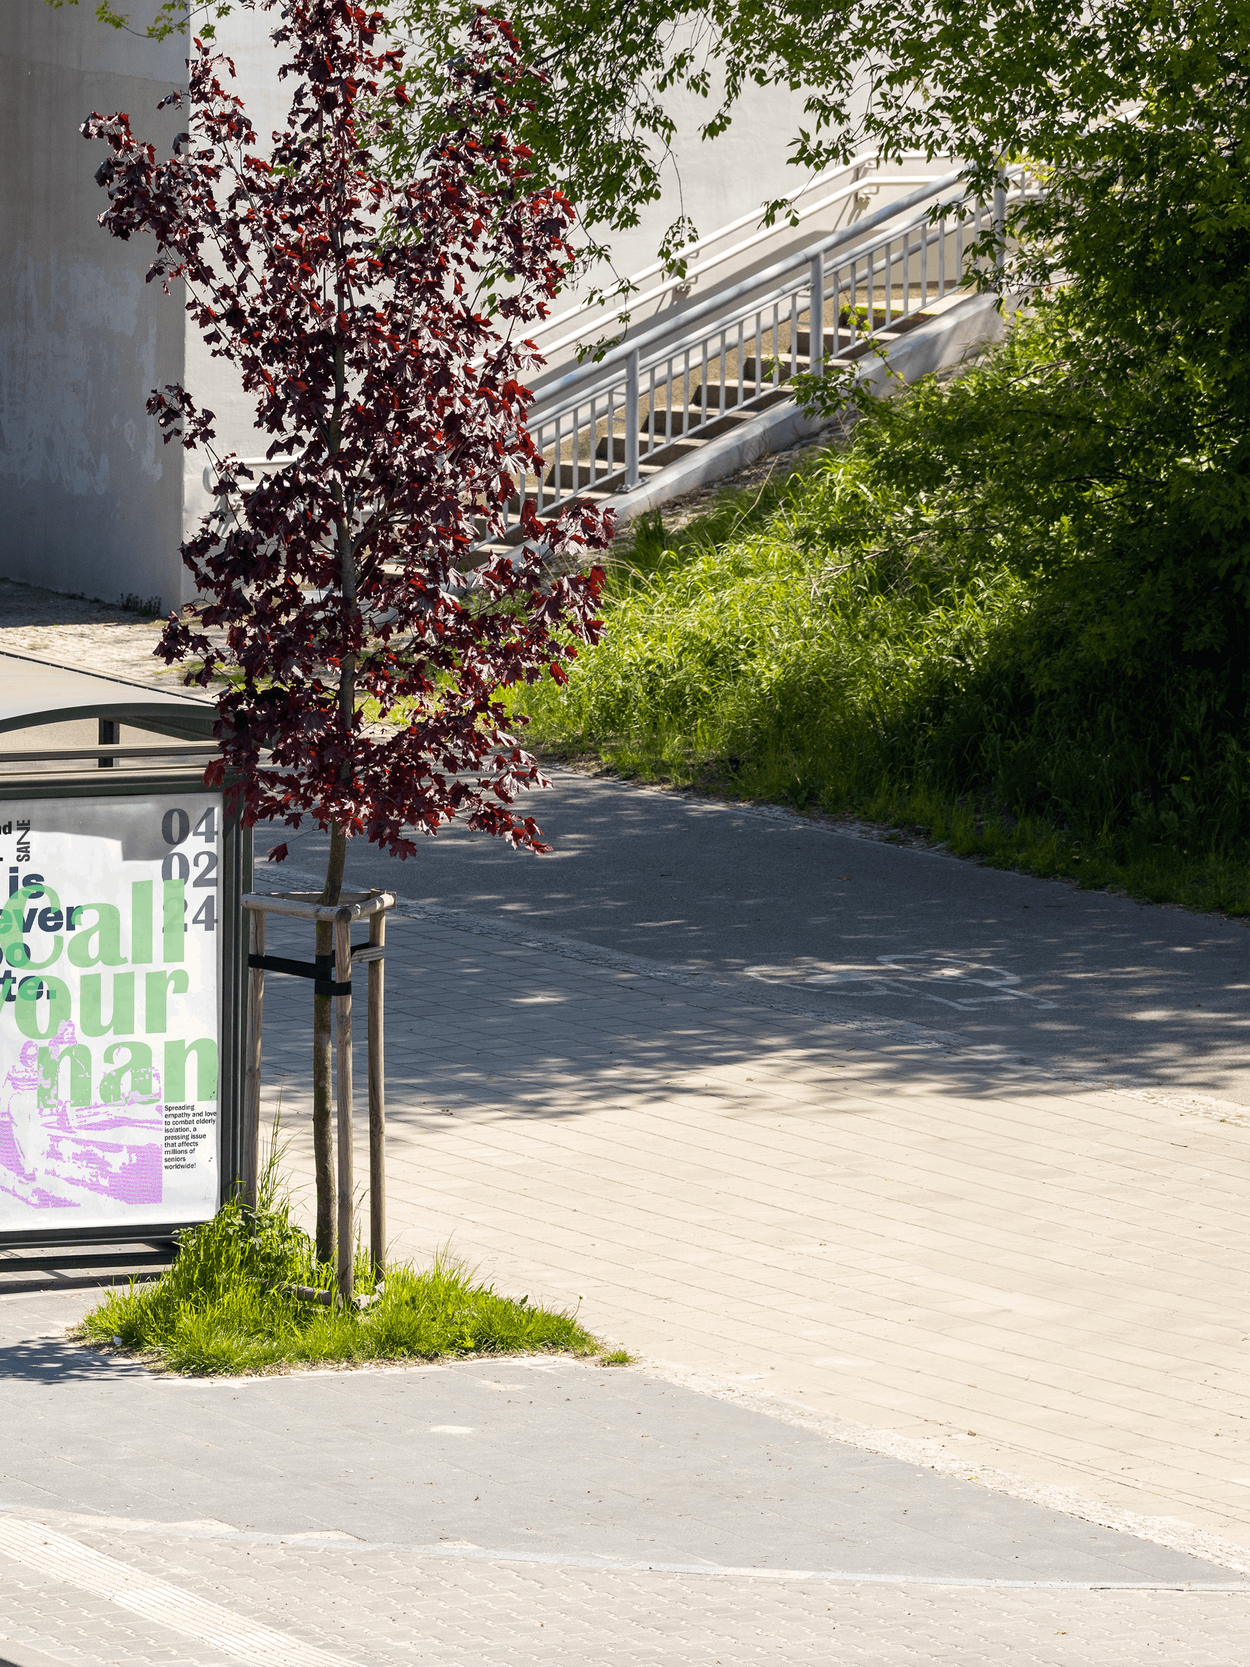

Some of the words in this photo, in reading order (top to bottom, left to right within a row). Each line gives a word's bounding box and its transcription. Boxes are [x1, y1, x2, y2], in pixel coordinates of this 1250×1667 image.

[162, 807, 218, 845] 04
[9, 866, 45, 900] is
[162, 851, 218, 889] 02
[0, 879, 184, 970] Call
[162, 895, 218, 933] 24
[37, 1038, 218, 1108] nan
[164, 1104, 195, 1112] Spreading
